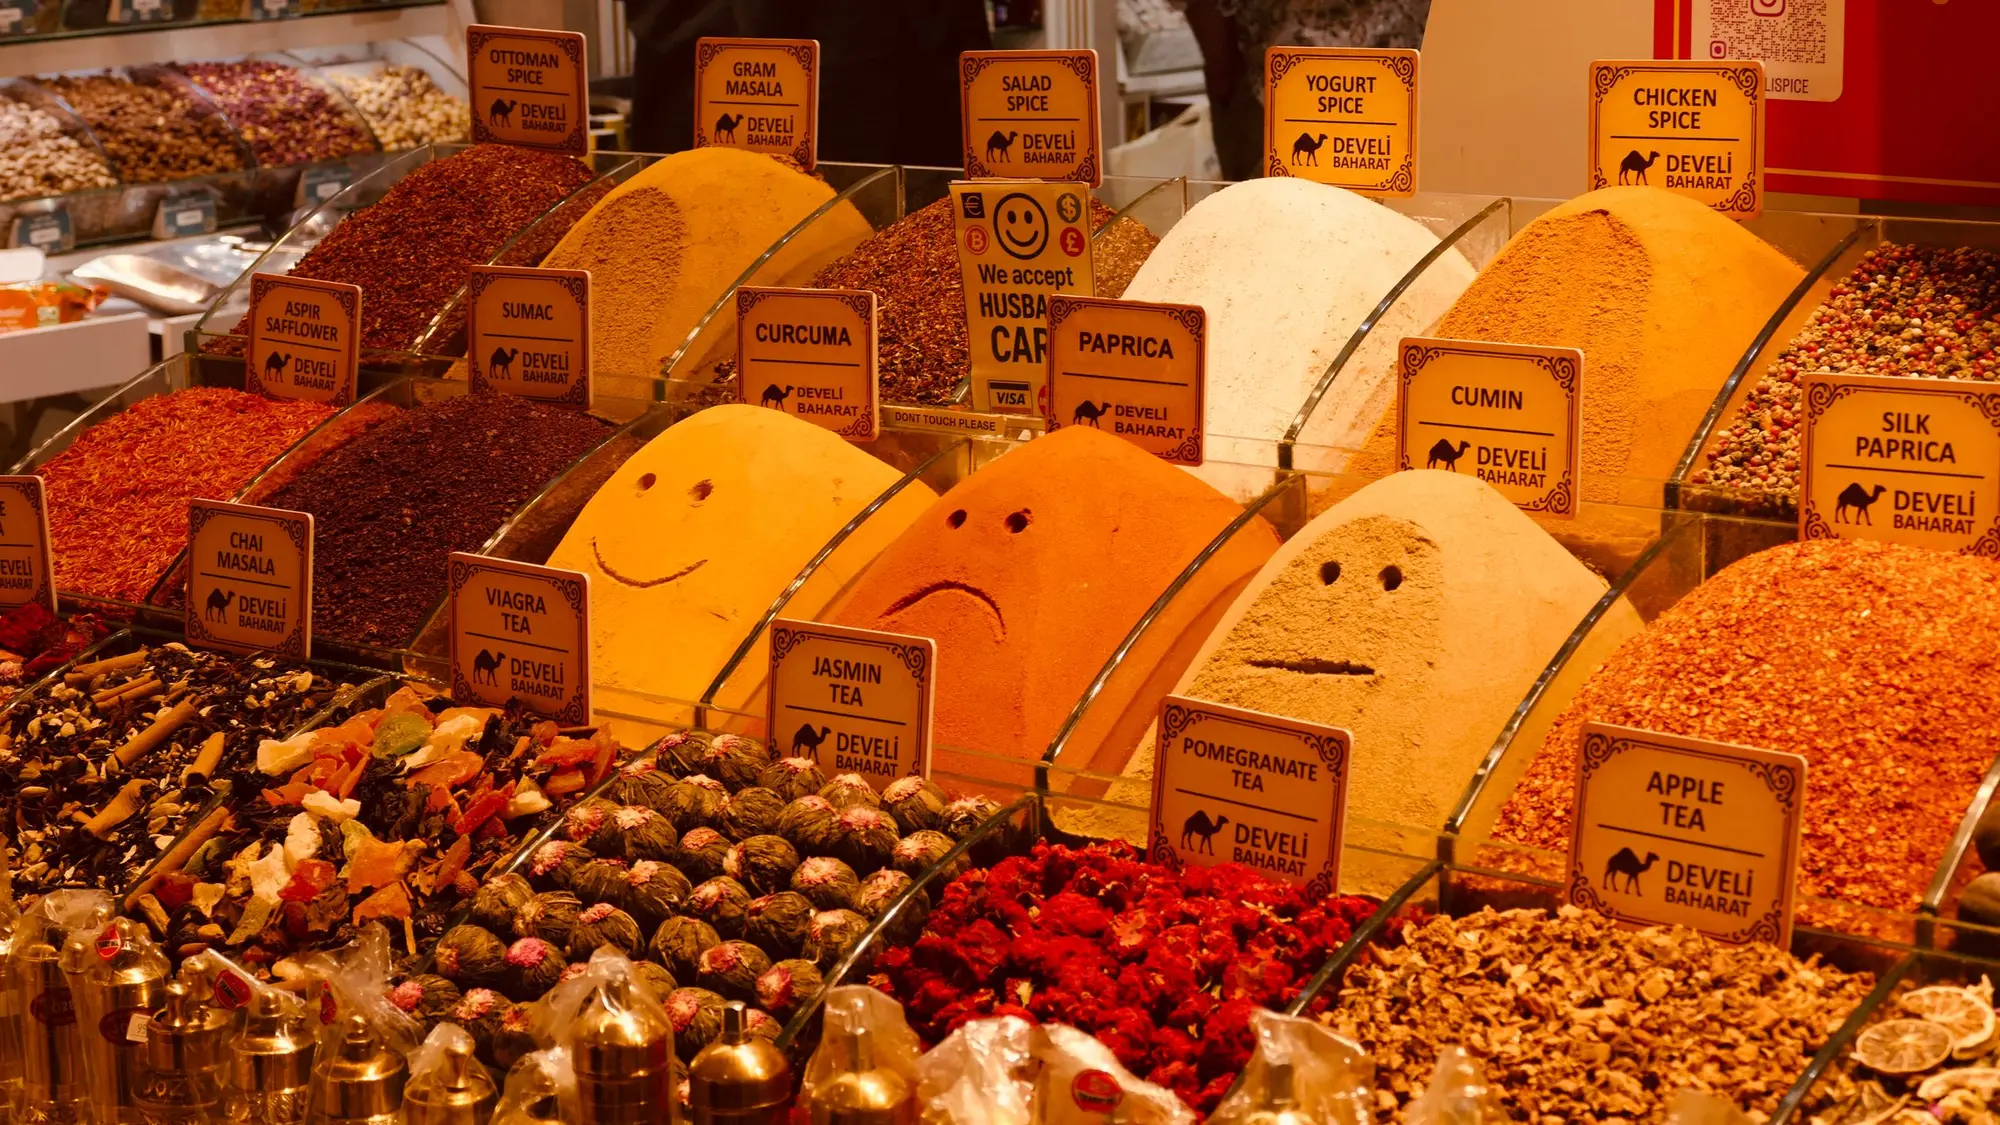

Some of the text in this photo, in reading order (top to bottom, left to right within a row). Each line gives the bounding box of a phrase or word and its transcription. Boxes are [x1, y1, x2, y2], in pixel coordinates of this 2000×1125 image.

[490, 50, 559, 68] OTTOMAN
[507, 68, 543, 85] SPICE
[733, 62, 776, 78] GRAM
[725, 80, 783, 97] MASALA
[1002, 75, 1051, 92] SALAD
[1307, 75, 1375, 93] YOGURT
[1765, 78, 1808, 93] LISPICE
[1007, 95, 1049, 112] SPICE
[1317, 97, 1363, 114] SPICE
[1634, 89, 1717, 107] CHICKEN
[521, 103, 567, 121] DEVELİ
[1649, 111, 1700, 129] SPICE
[521, 119, 567, 133] BAHARAT
[747, 114, 794, 134] DEVELİ
[747, 133, 793, 147] BAHARAT
[1023, 131, 1074, 151] DEVELİ
[1333, 135, 1391, 155] DEVELİ
[1024, 150, 1075, 164] BAHARAT
[1333, 155, 1390, 170] BAHARAT
[1666, 153, 1731, 174] DEVELİ
[1666, 175, 1731, 189] BAHARAT
[978, 264, 1074, 290] We accept
[284, 301, 320, 320] ASPIR
[502, 302, 553, 320] SUMAC
[979, 293, 1047, 319] HUSBA
[265, 318, 338, 341] SAFFLOWER
[756, 324, 851, 346] CURCUMA
[991, 325, 1047, 363] CAR
[1079, 332, 1173, 359] PAPRICA
[294, 357, 337, 377] DEVELİ
[522, 351, 570, 370] DEVELİ
[294, 374, 336, 390] BAHARAT
[522, 368, 569, 384] BAHARAT
[996, 392, 1025, 405] VISA
[1451, 386, 1523, 410] CUMIN
[797, 402, 858, 416] BAHARAT
[895, 412, 995, 431] DONT TOUCH PLEASE
[1115, 422, 1184, 439] BAHARAT
[1882, 412, 1929, 434] SILK
[1477, 445, 1546, 469] DEVELİ
[1856, 438, 1955, 463] PAPRICA
[1893, 489, 1974, 515] DEVELİ
[1893, 513, 1974, 535] BAHARAT
[229, 531, 263, 550] CHAI
[0, 556, 32, 576] EVELİ
[217, 550, 275, 575] MASALA
[0, 578, 33, 589] AHARAT
[239, 595, 286, 619] DEVELİ
[485, 587, 546, 614] VIAGRA
[238, 614, 285, 634] BAHARAT
[501, 612, 531, 635] TEA
[510, 657, 564, 683] DEVELİ
[812, 656, 881, 684] JASMIN
[510, 679, 564, 700] BAHARAT
[829, 684, 862, 707] TEA
[836, 730, 898, 756] DEVELİ
[836, 754, 898, 777] BAHARAT
[1183, 739, 1317, 781] POMEGRANATE
[1232, 770, 1264, 792] TEA
[1647, 772, 1724, 804] APPLE
[1659, 804, 1705, 832] TEA
[1235, 823, 1308, 858] DEVELİ
[1234, 847, 1306, 876] BAHARAT
[1666, 861, 1754, 895] DEVELİ
[1665, 887, 1750, 917] BAHARAT
